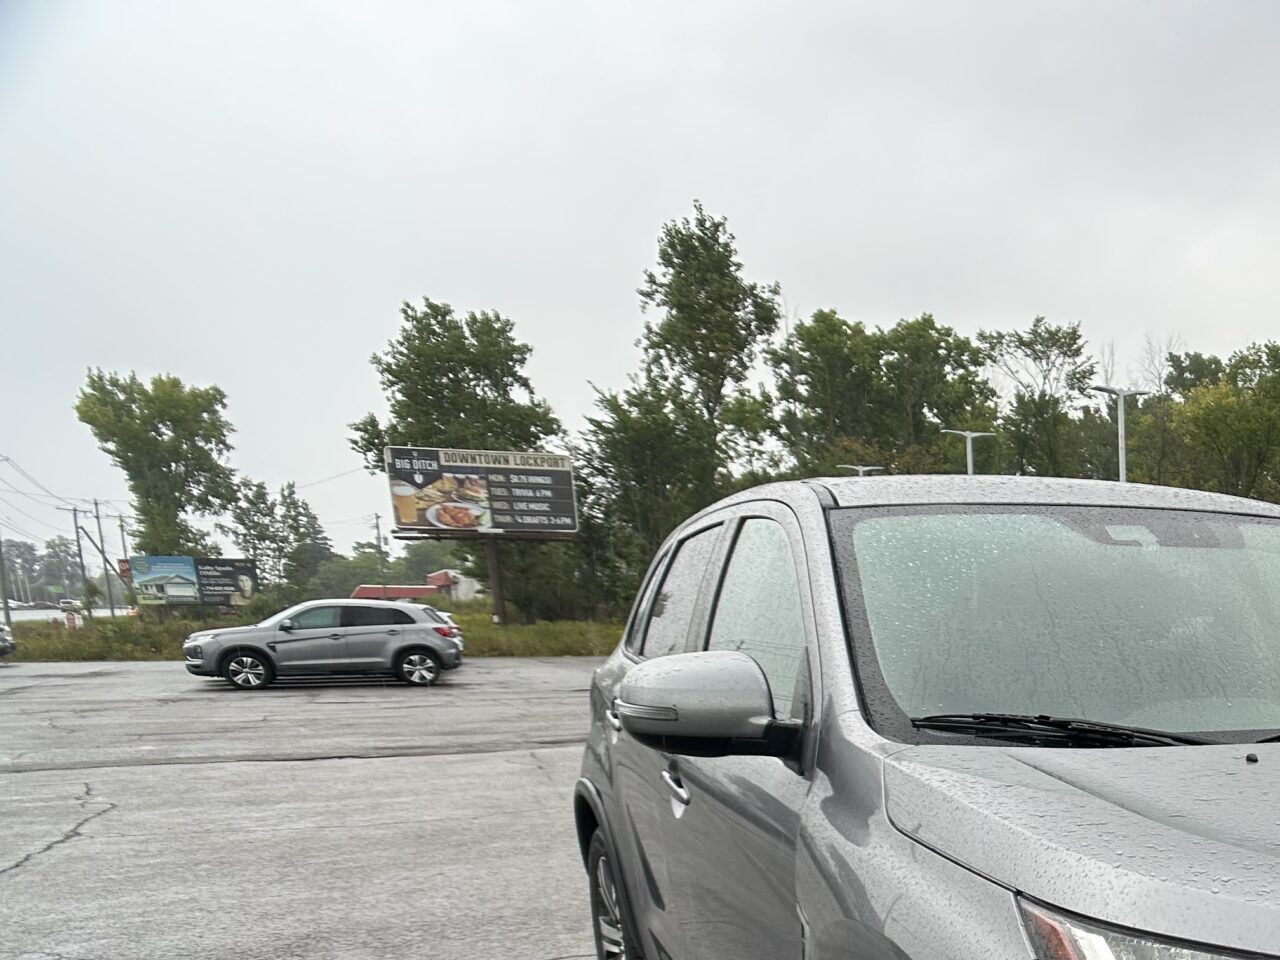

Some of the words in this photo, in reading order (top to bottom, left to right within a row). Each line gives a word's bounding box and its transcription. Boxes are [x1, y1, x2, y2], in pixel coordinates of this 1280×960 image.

[394, 458, 411, 469] BIG
[412, 458, 439, 471] DITCH
[444, 451, 510, 466] DOWNTOWN
[513, 455, 566, 469] LOCKPORT
[511, 487, 534, 497] TRIVIA
[540, 489, 552, 497] PM
[513, 502, 528, 510] LIVE
[528, 502, 551, 511] MUSIC
